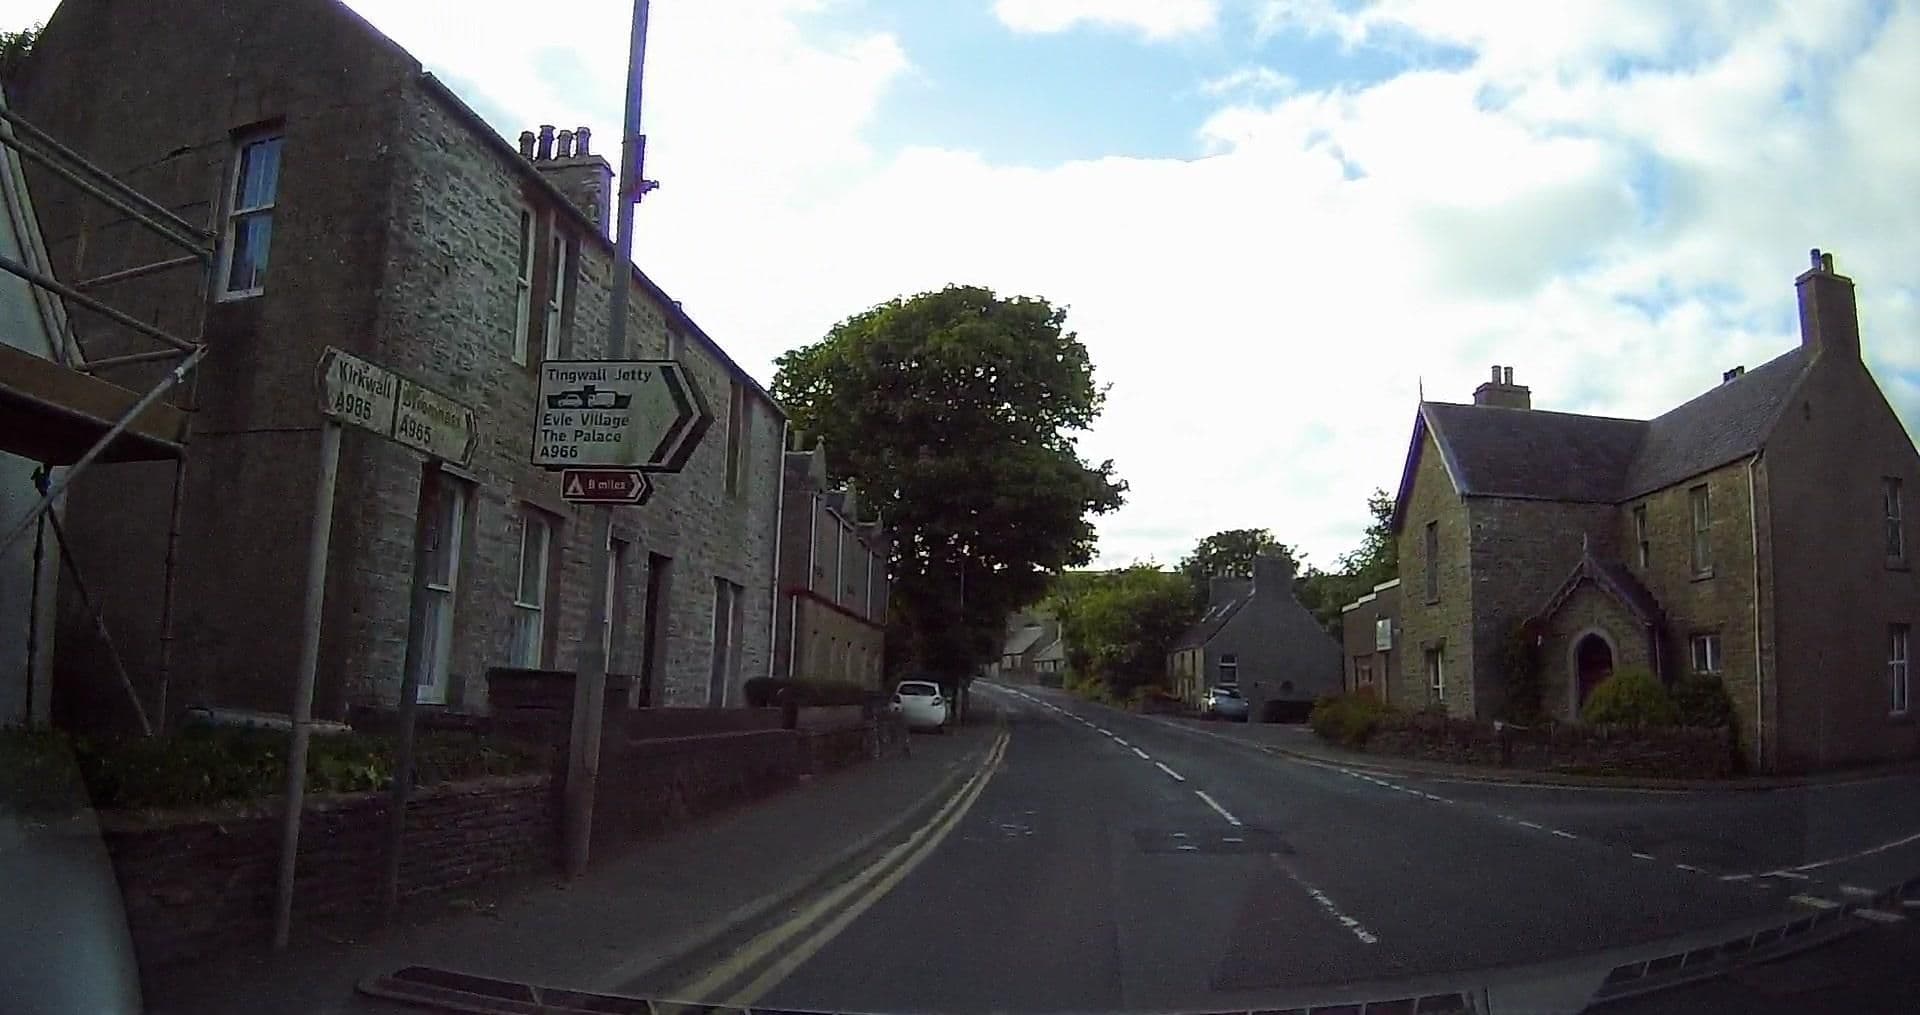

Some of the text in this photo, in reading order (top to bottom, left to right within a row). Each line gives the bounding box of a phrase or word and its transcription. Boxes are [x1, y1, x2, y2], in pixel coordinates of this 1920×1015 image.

[338, 360, 392, 399] Kirkwall
[548, 368, 652, 383] Tingwall Jetty
[399, 414, 432, 444] A965
[543, 413, 629, 430] Evie Village
[541, 430, 622, 443] The Palace
[540, 446, 578, 458] A966
[598, 480, 626, 490] miles
